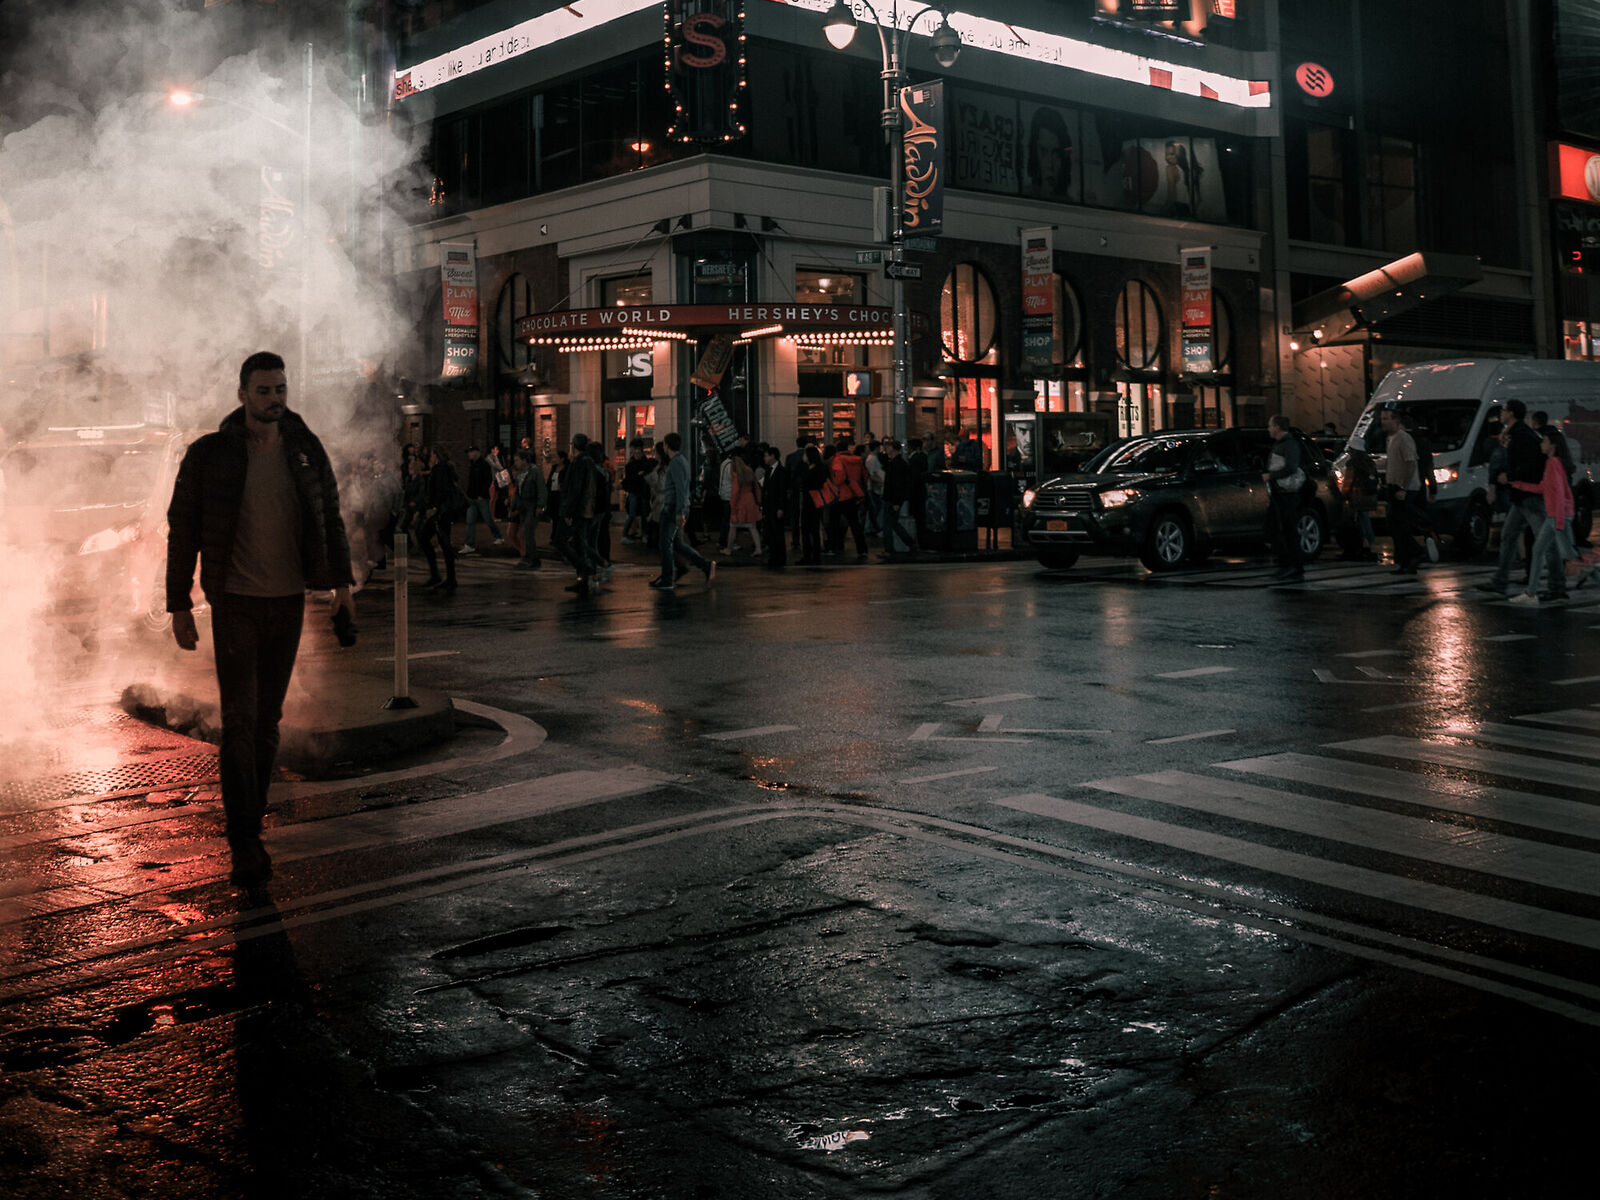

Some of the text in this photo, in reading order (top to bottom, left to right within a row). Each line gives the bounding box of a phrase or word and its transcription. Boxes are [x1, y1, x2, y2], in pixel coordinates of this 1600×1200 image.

[900, 85, 937, 228] Aladdin
[1024, 276, 1051, 288] PLAY
[447, 288, 474, 298] PLAY
[1184, 292, 1209, 301] PLAY
[448, 305, 472, 320] Mix
[728, 307, 839, 321] HERSHEY'S
[521, 309, 671, 333] CHOCOLATE WORLD
[1023, 336, 1051, 348] SHOP
[447, 347, 475, 358] SHOP
[1184, 346, 1209, 356] SHOP
[701, 395, 739, 452] HERSHEY
